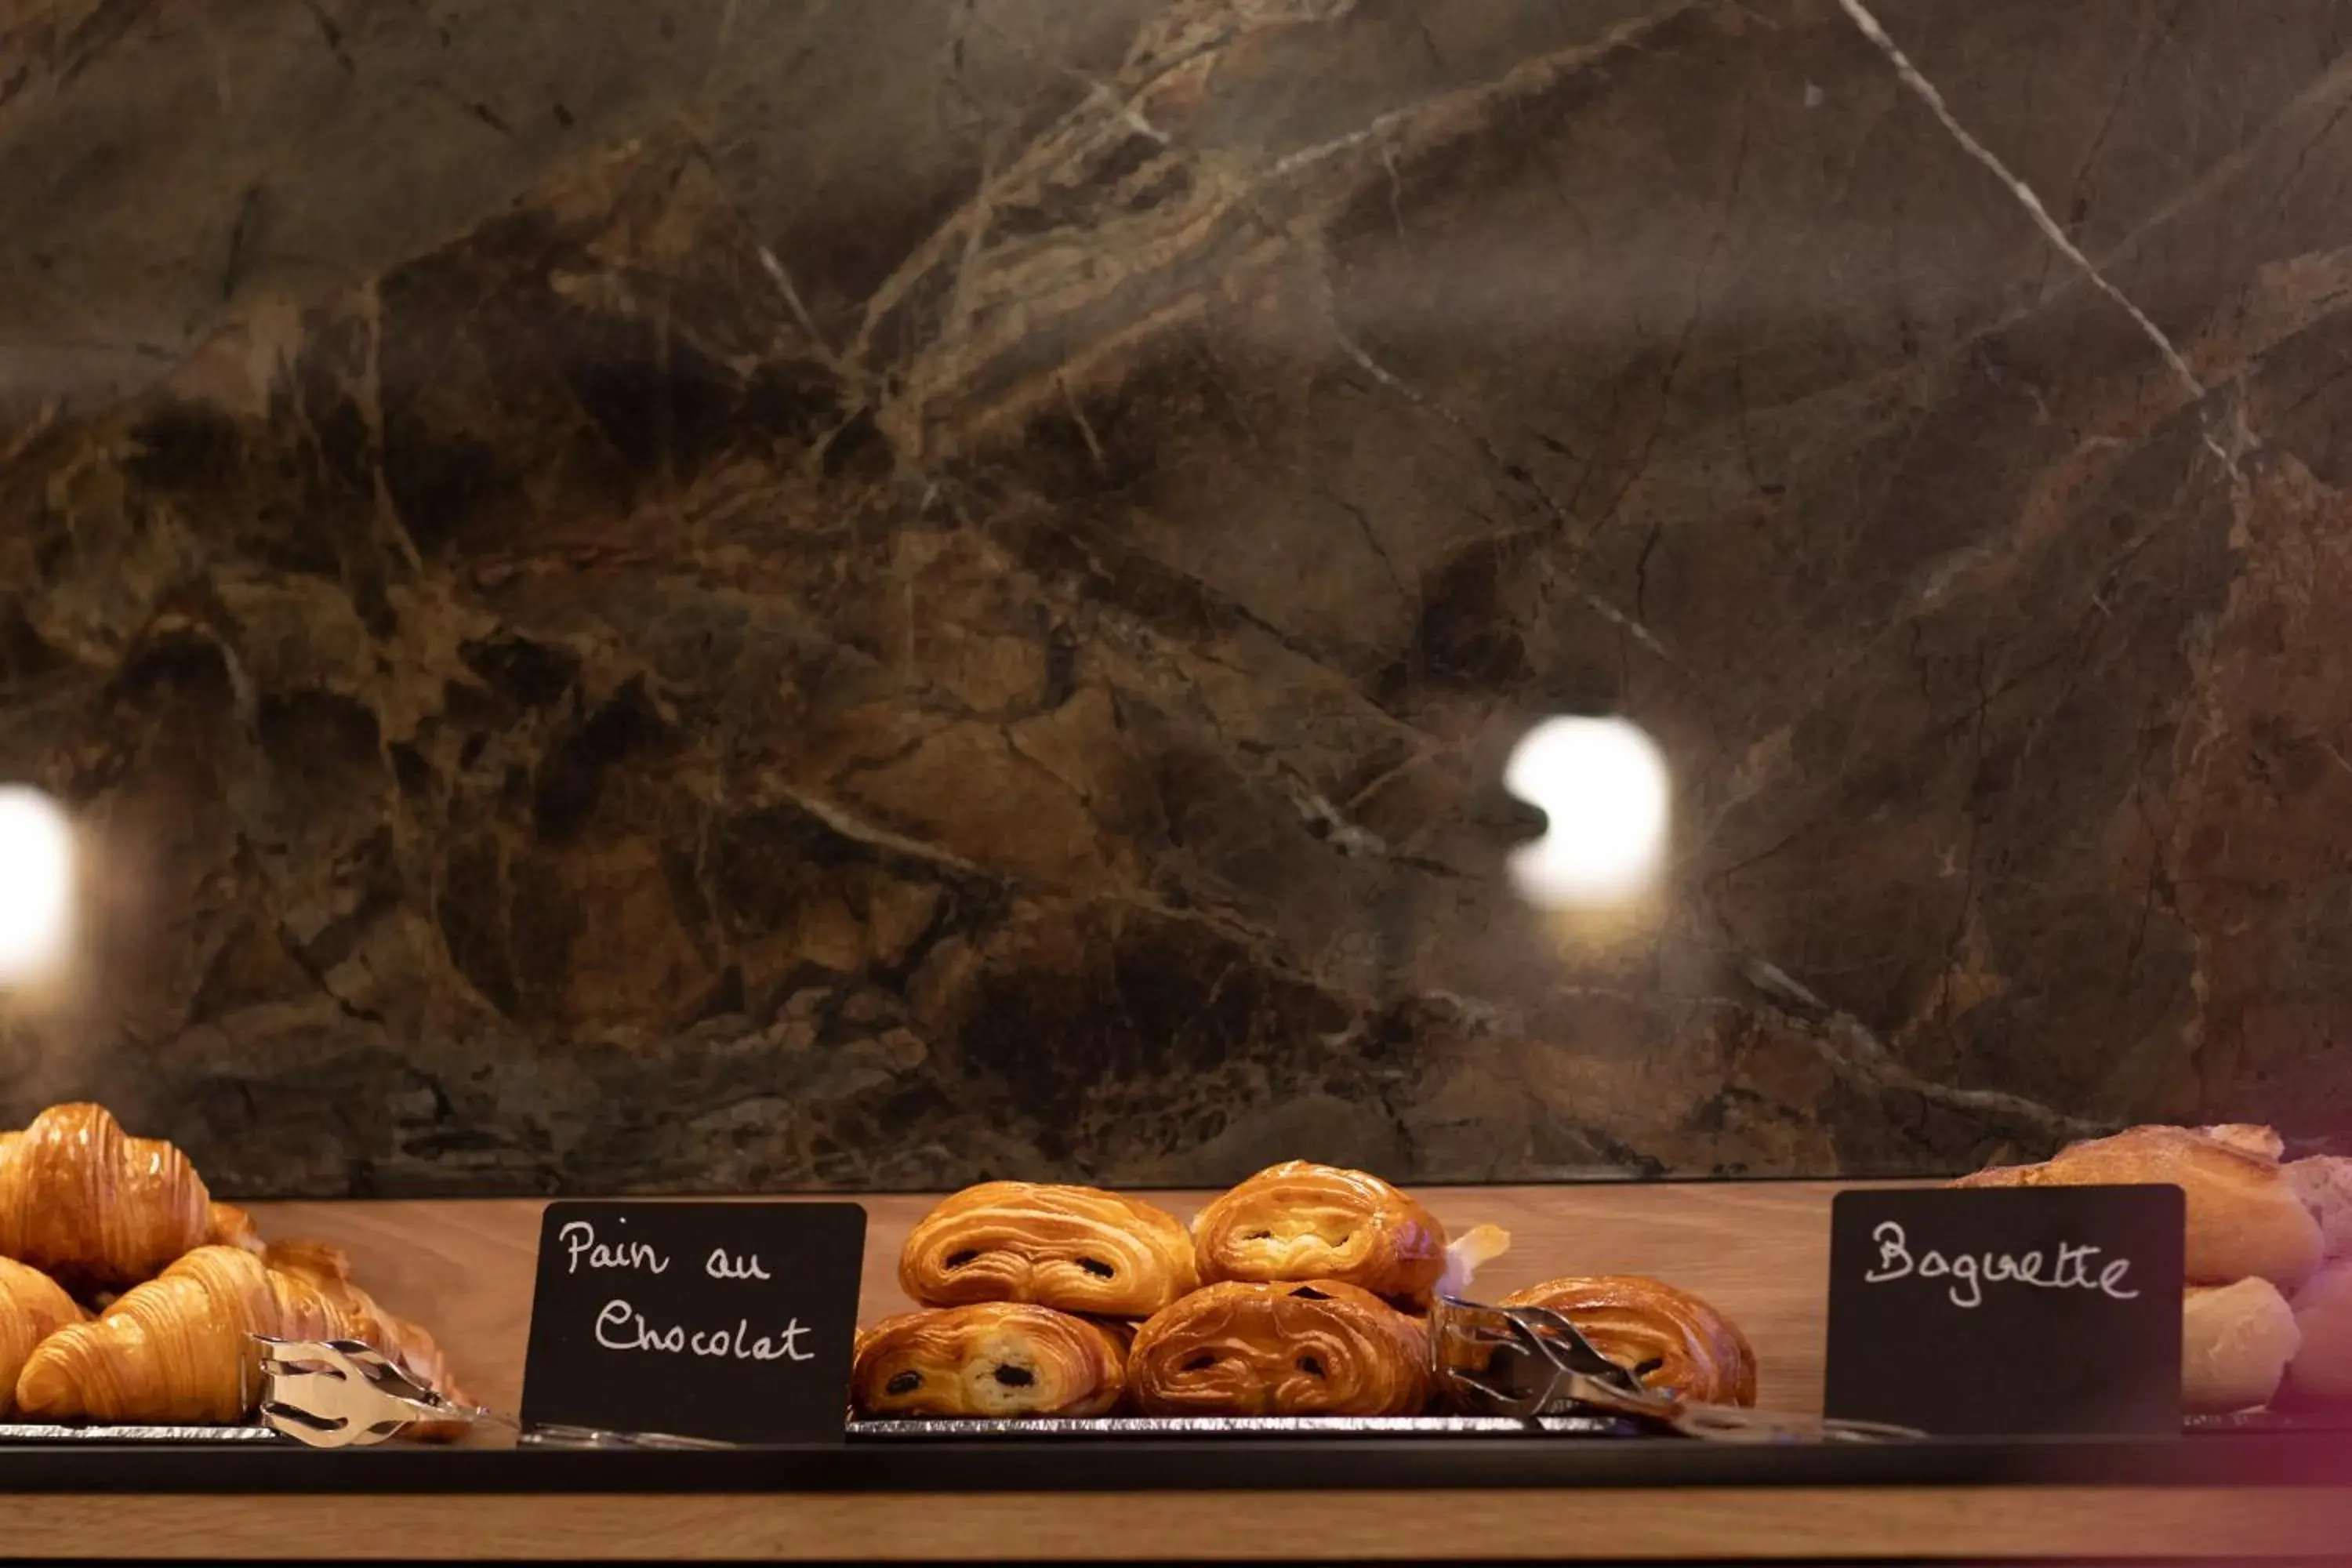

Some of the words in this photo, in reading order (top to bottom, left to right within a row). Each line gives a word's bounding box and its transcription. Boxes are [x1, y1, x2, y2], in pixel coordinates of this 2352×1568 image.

[559, 1217, 670, 1274] Pain
[706, 1248, 771, 1279] au
[1865, 1221, 2139, 1307] Baguette
[595, 1299, 815, 1360] Chocolat
